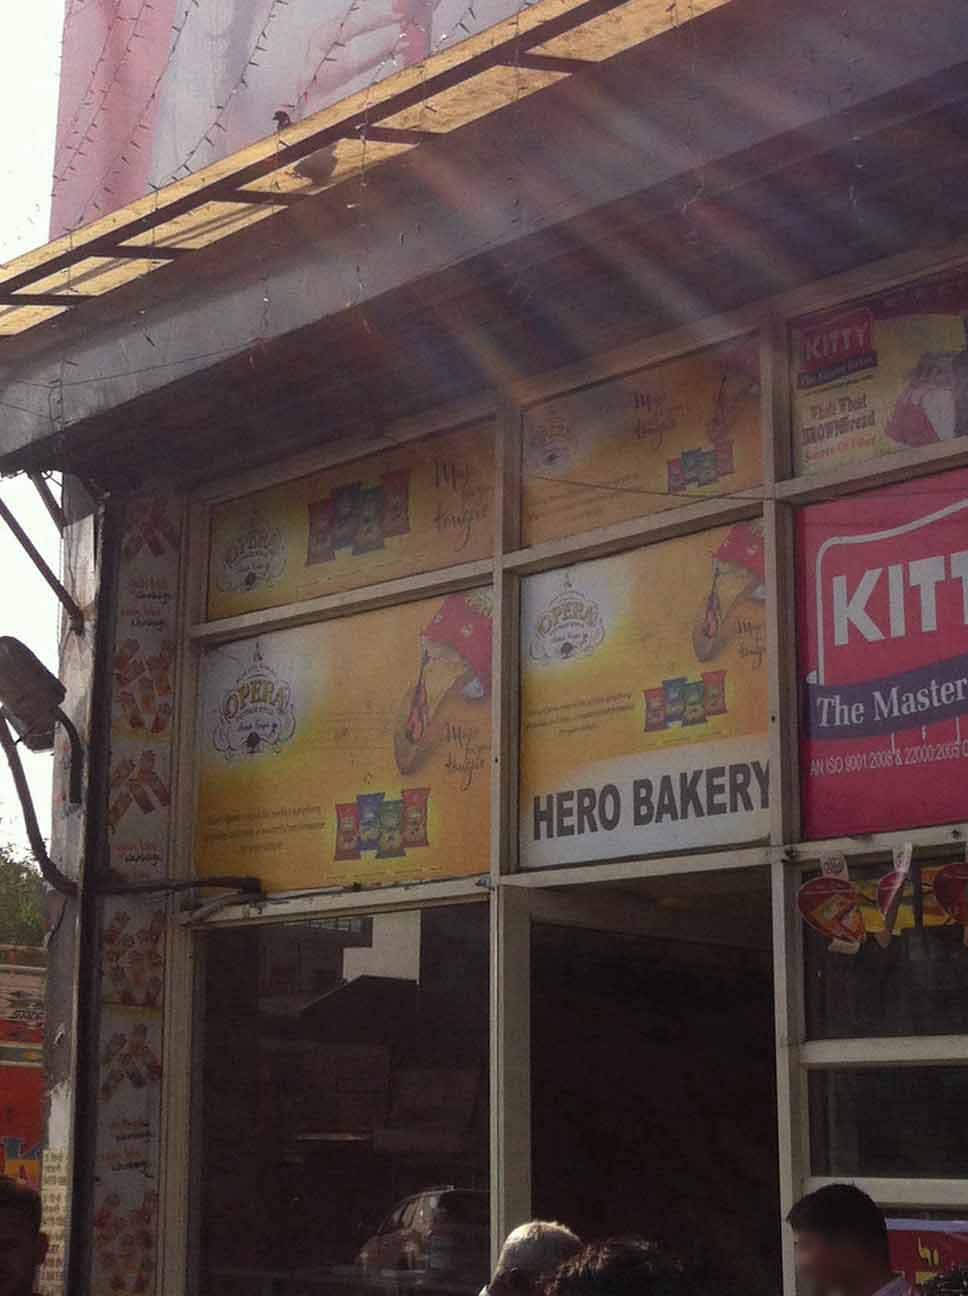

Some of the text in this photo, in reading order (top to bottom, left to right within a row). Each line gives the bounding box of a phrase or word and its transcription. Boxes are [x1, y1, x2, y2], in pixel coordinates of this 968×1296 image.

[805, 322, 868, 360] KITTY
[537, 600, 594, 636] OPERA
[224, 678, 288, 720] OPERA
[816, 695, 864, 728] The
[872, 677, 968, 722] Master
[533, 759, 770, 841] HERO BAKERY
